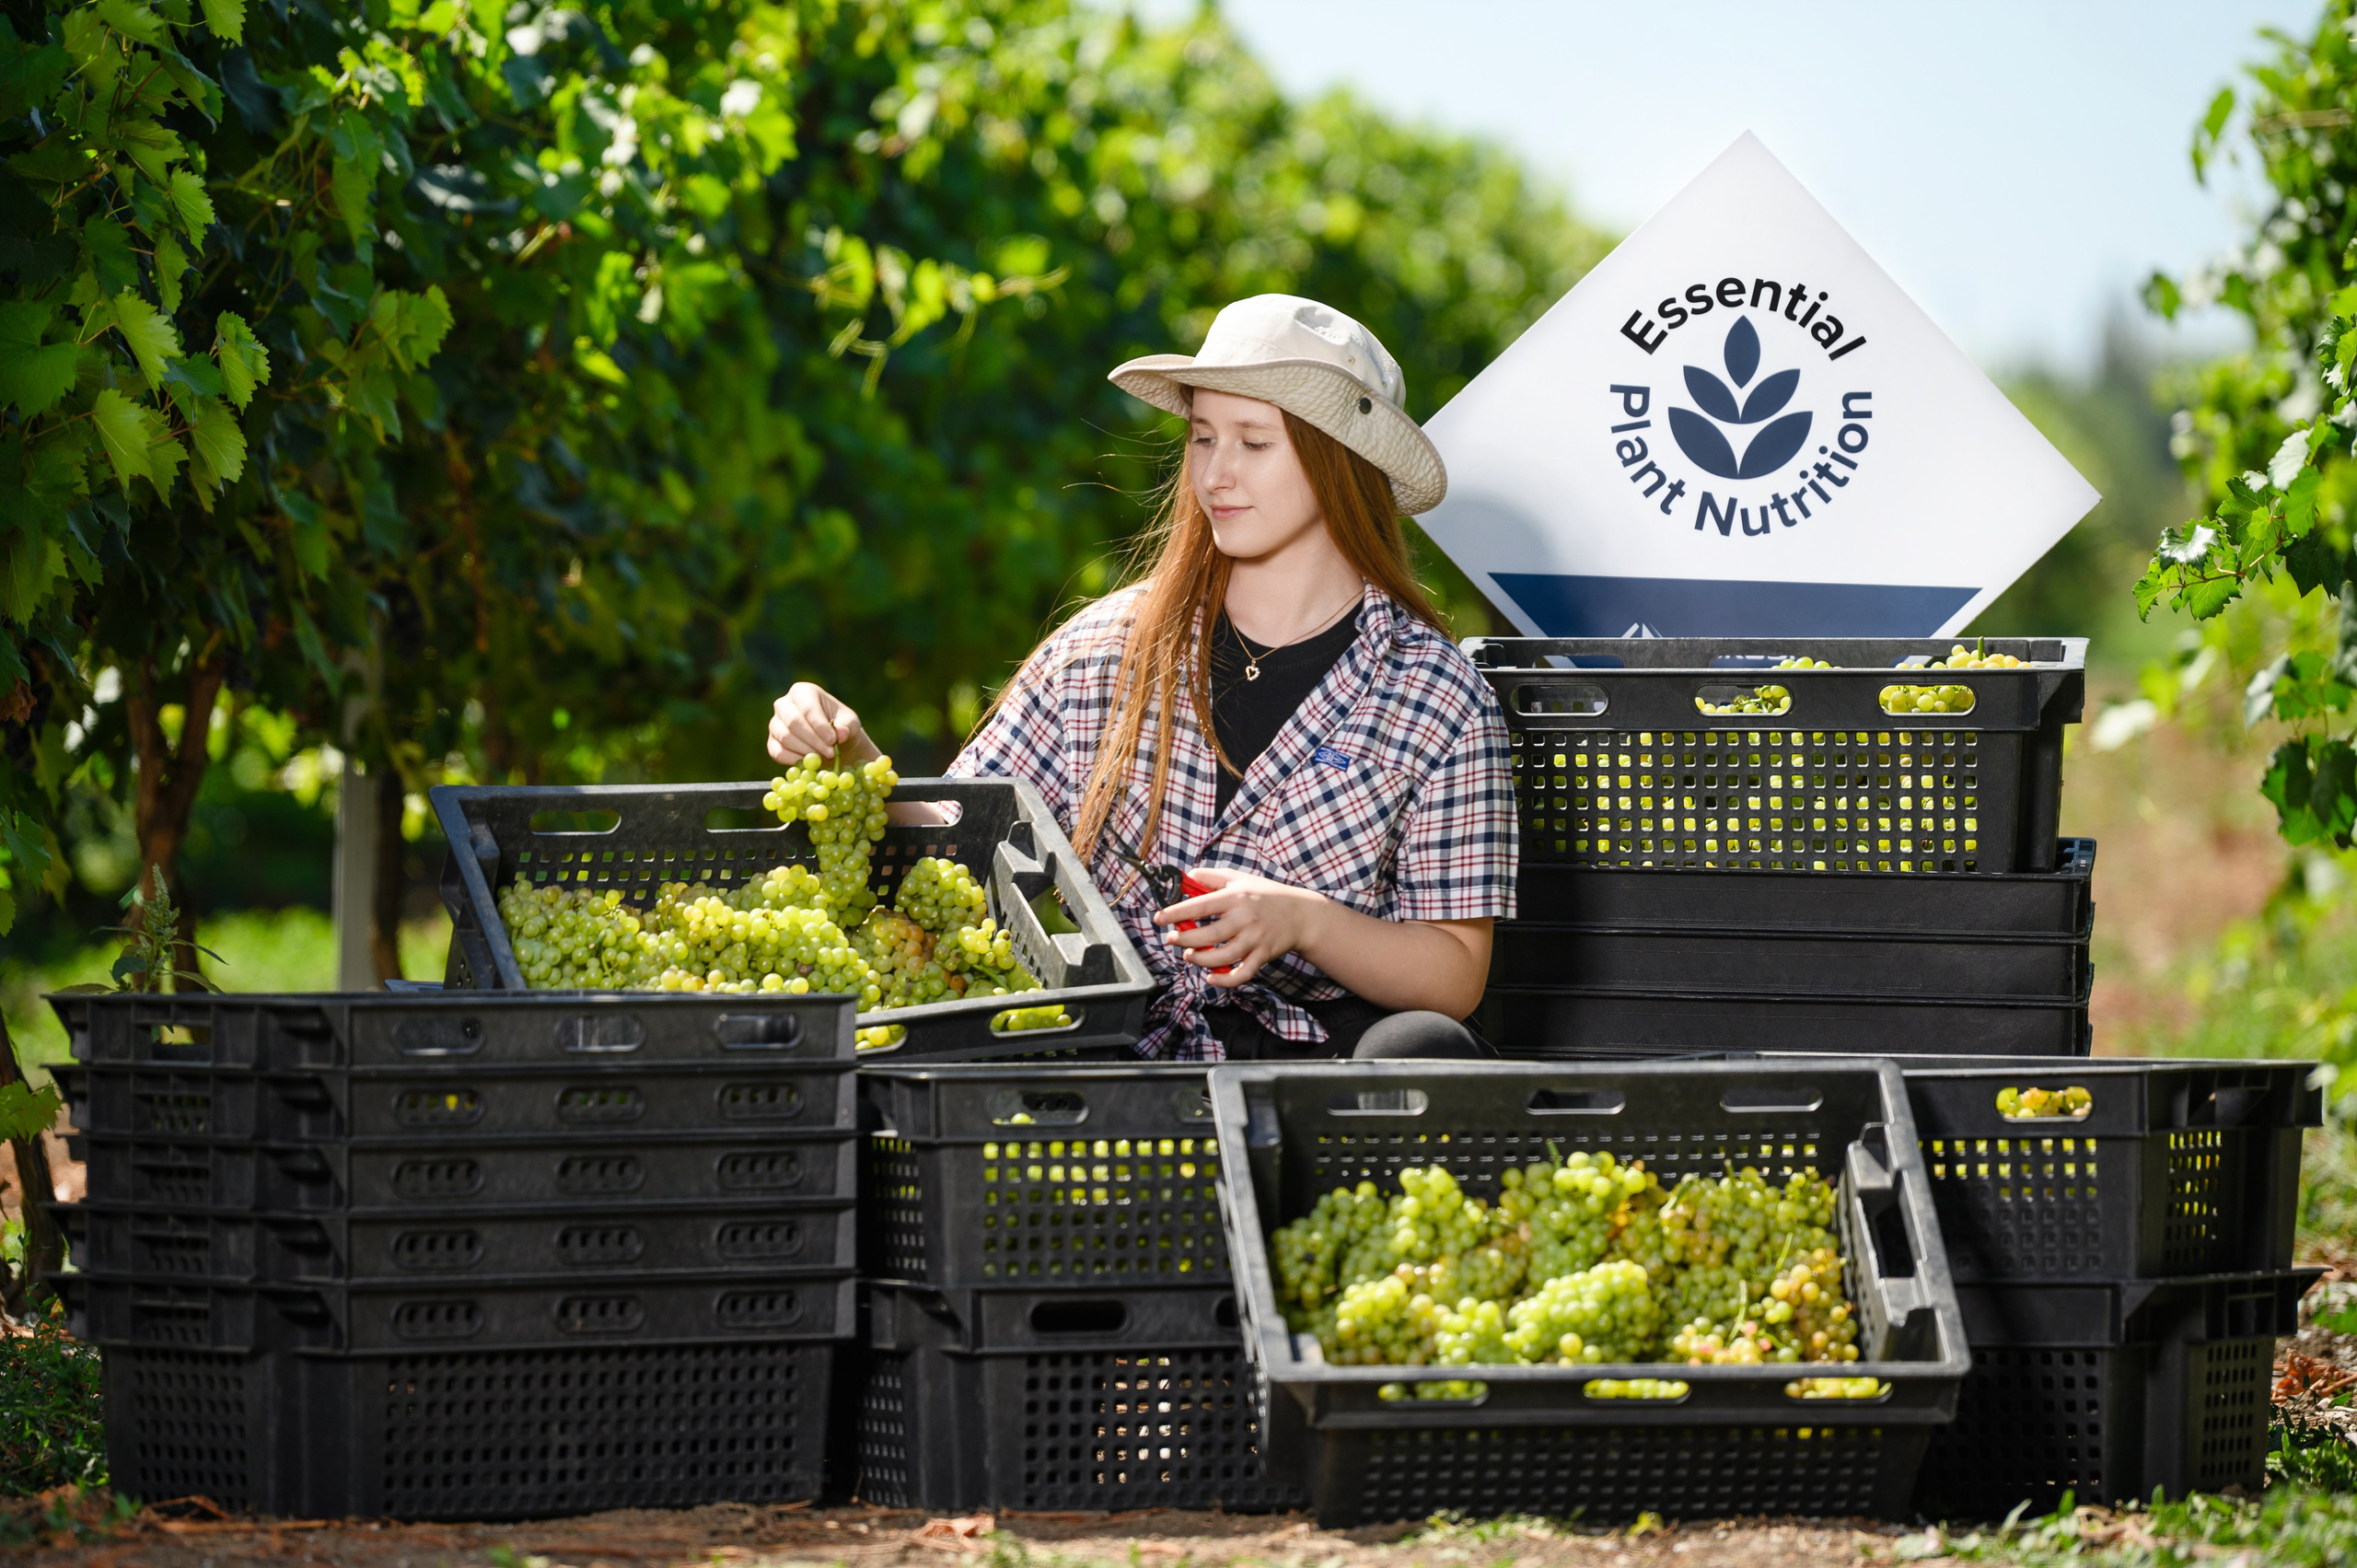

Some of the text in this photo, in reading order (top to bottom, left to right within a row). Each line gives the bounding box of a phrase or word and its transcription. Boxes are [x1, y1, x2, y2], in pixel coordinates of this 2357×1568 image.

[1620, 277, 1867, 362] Essential
[1609, 384, 1873, 537] Plant Nutrition
